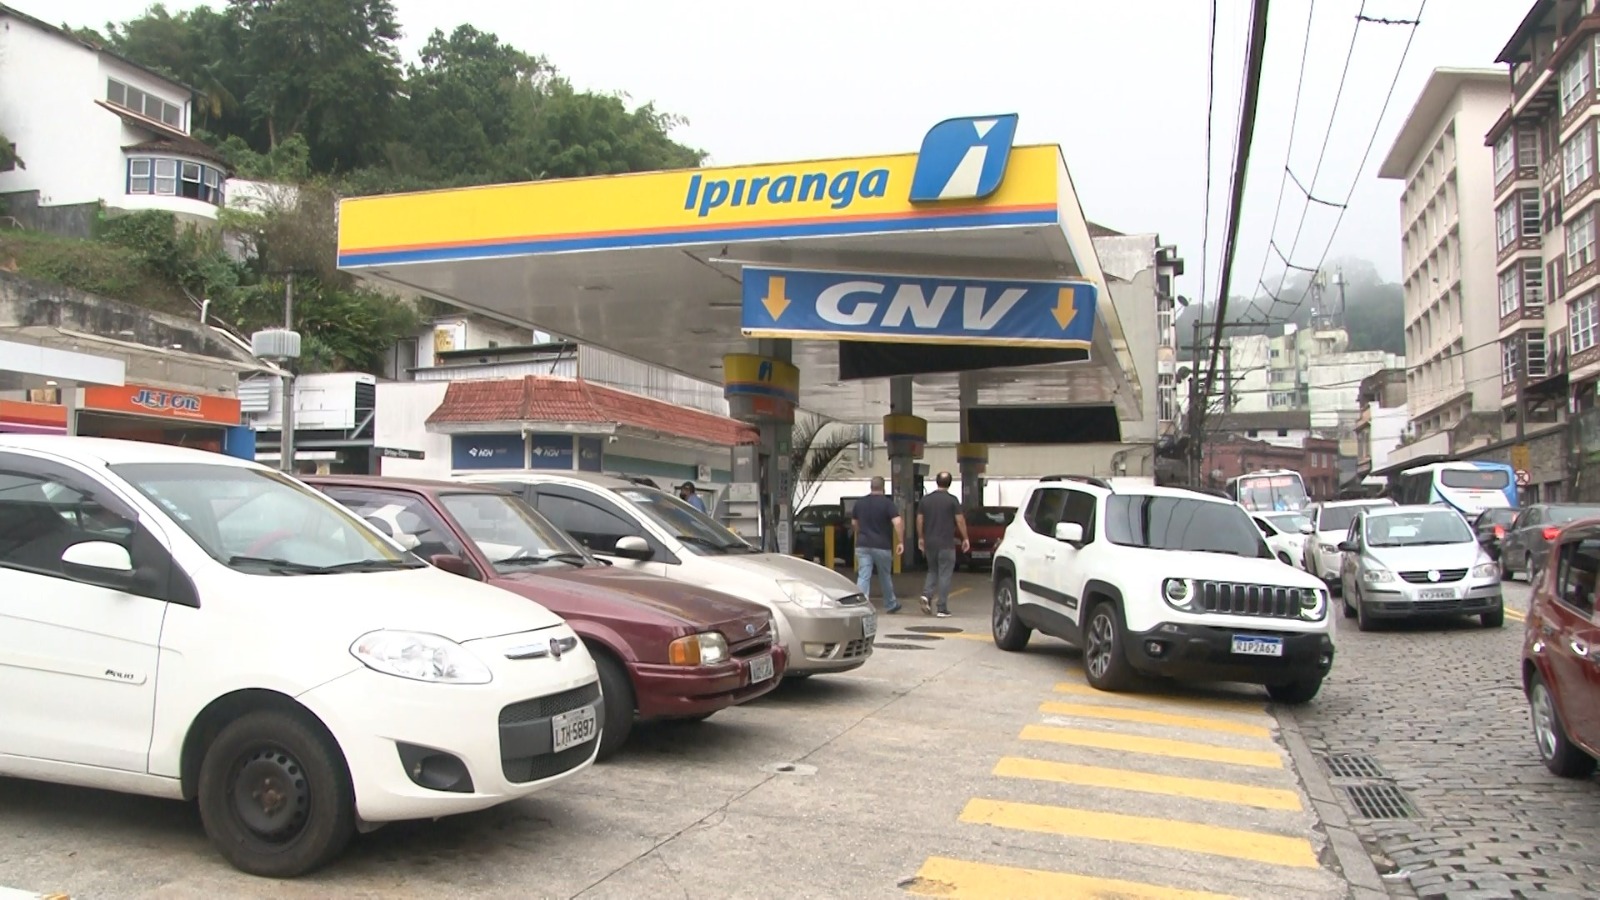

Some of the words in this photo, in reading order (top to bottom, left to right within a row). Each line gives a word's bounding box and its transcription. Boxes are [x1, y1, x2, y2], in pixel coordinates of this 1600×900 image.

[684, 168, 890, 217] Ipiranga
[814, 280, 1029, 331] GNV
[131, 389, 171, 410] JET
[171, 394, 201, 411] OIL
[1236, 642, 1277, 653] RIP2A62
